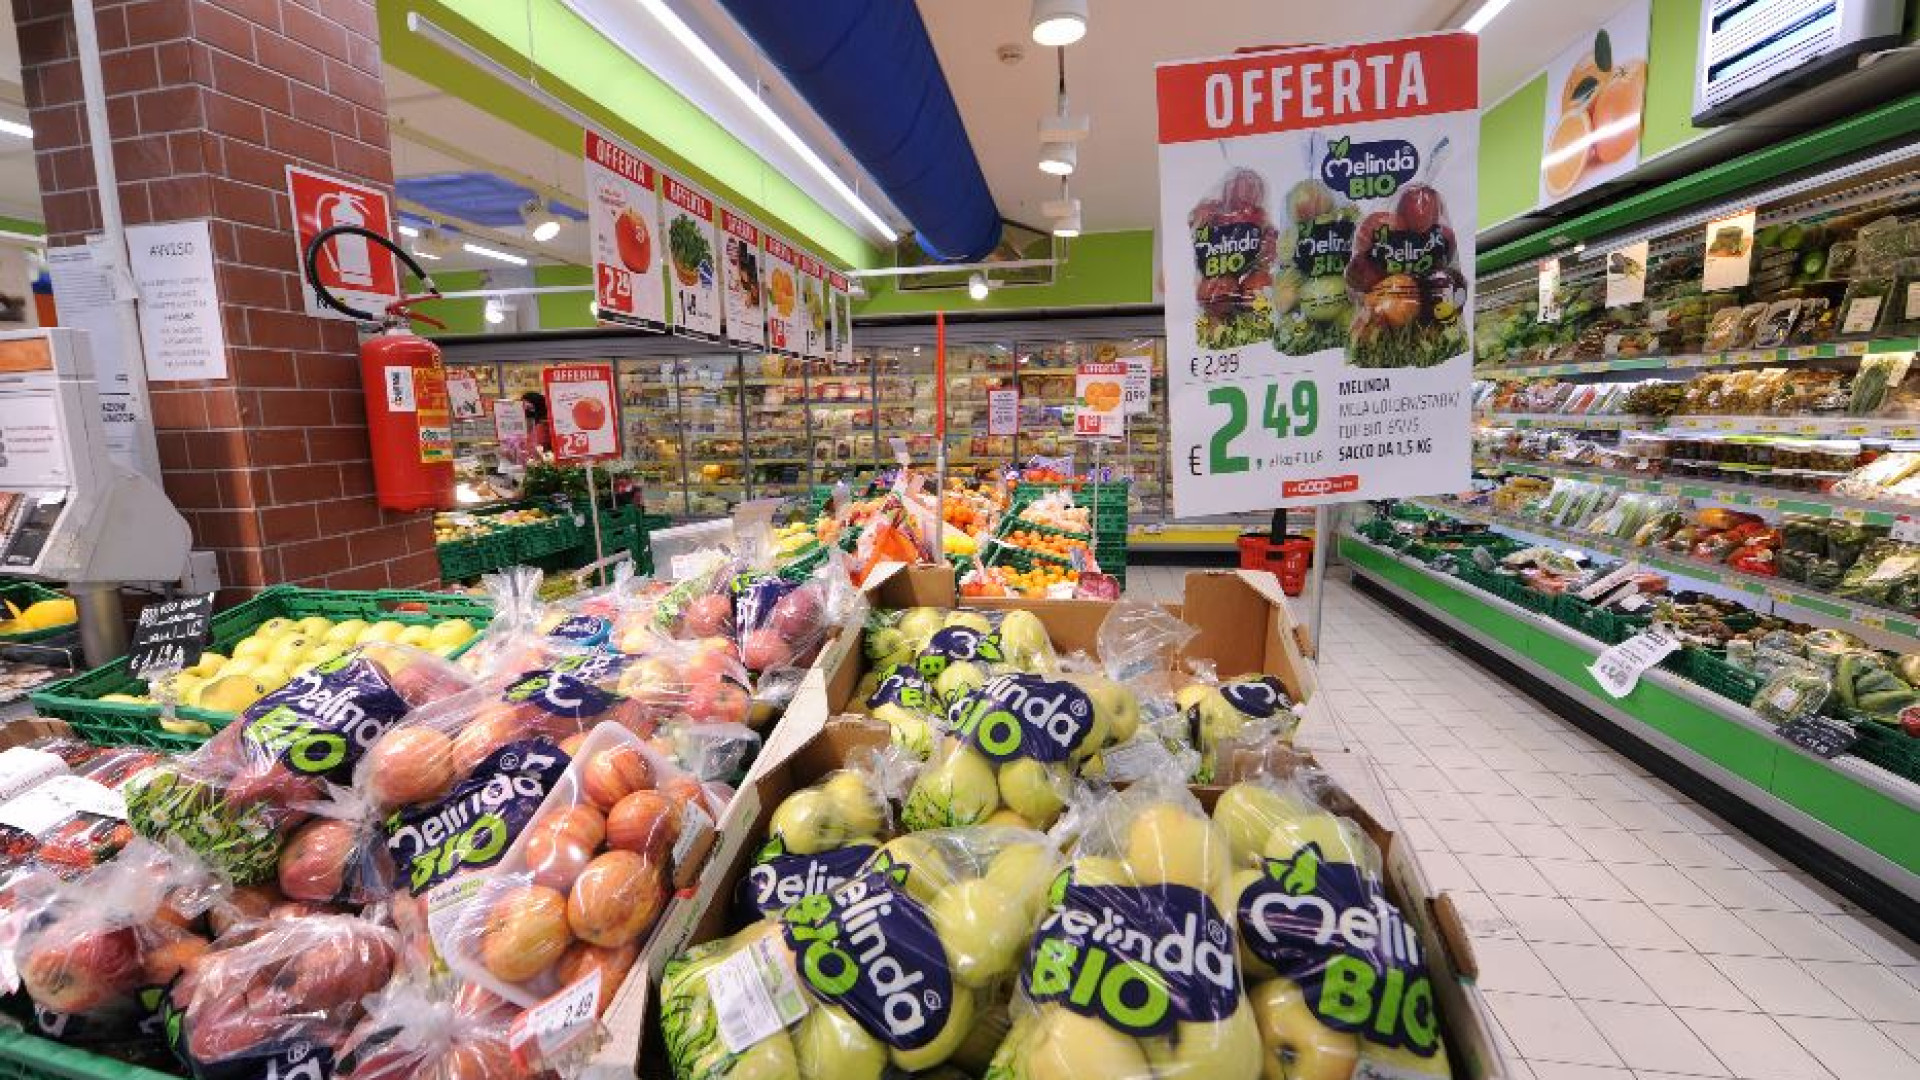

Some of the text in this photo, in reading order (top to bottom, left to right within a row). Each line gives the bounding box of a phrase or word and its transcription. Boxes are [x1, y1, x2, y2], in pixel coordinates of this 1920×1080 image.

[1205, 51, 1428, 128] OFFERTA
[596, 139, 645, 183] OFFERTA
[1327, 149, 1414, 179] Melinda
[1350, 174, 1397, 199] BIO
[1206, 252, 1246, 277] BIO
[553, 369, 600, 382] OFFERTA
[1191, 357, 1199, 377] €
[1339, 378, 1390, 396] MELINDA
[1188, 445, 1203, 476] €
[1339, 443, 1373, 461] SACCO
[1378, 441, 1394, 458] DA
[410, 814, 508, 896] BIO
[1250, 890, 1420, 967] Melin
[834, 880, 926, 1036] elinda
[1042, 905, 1234, 990] elinda
[1030, 938, 1170, 1028] BIO
[1317, 953, 1439, 1049] BIO
